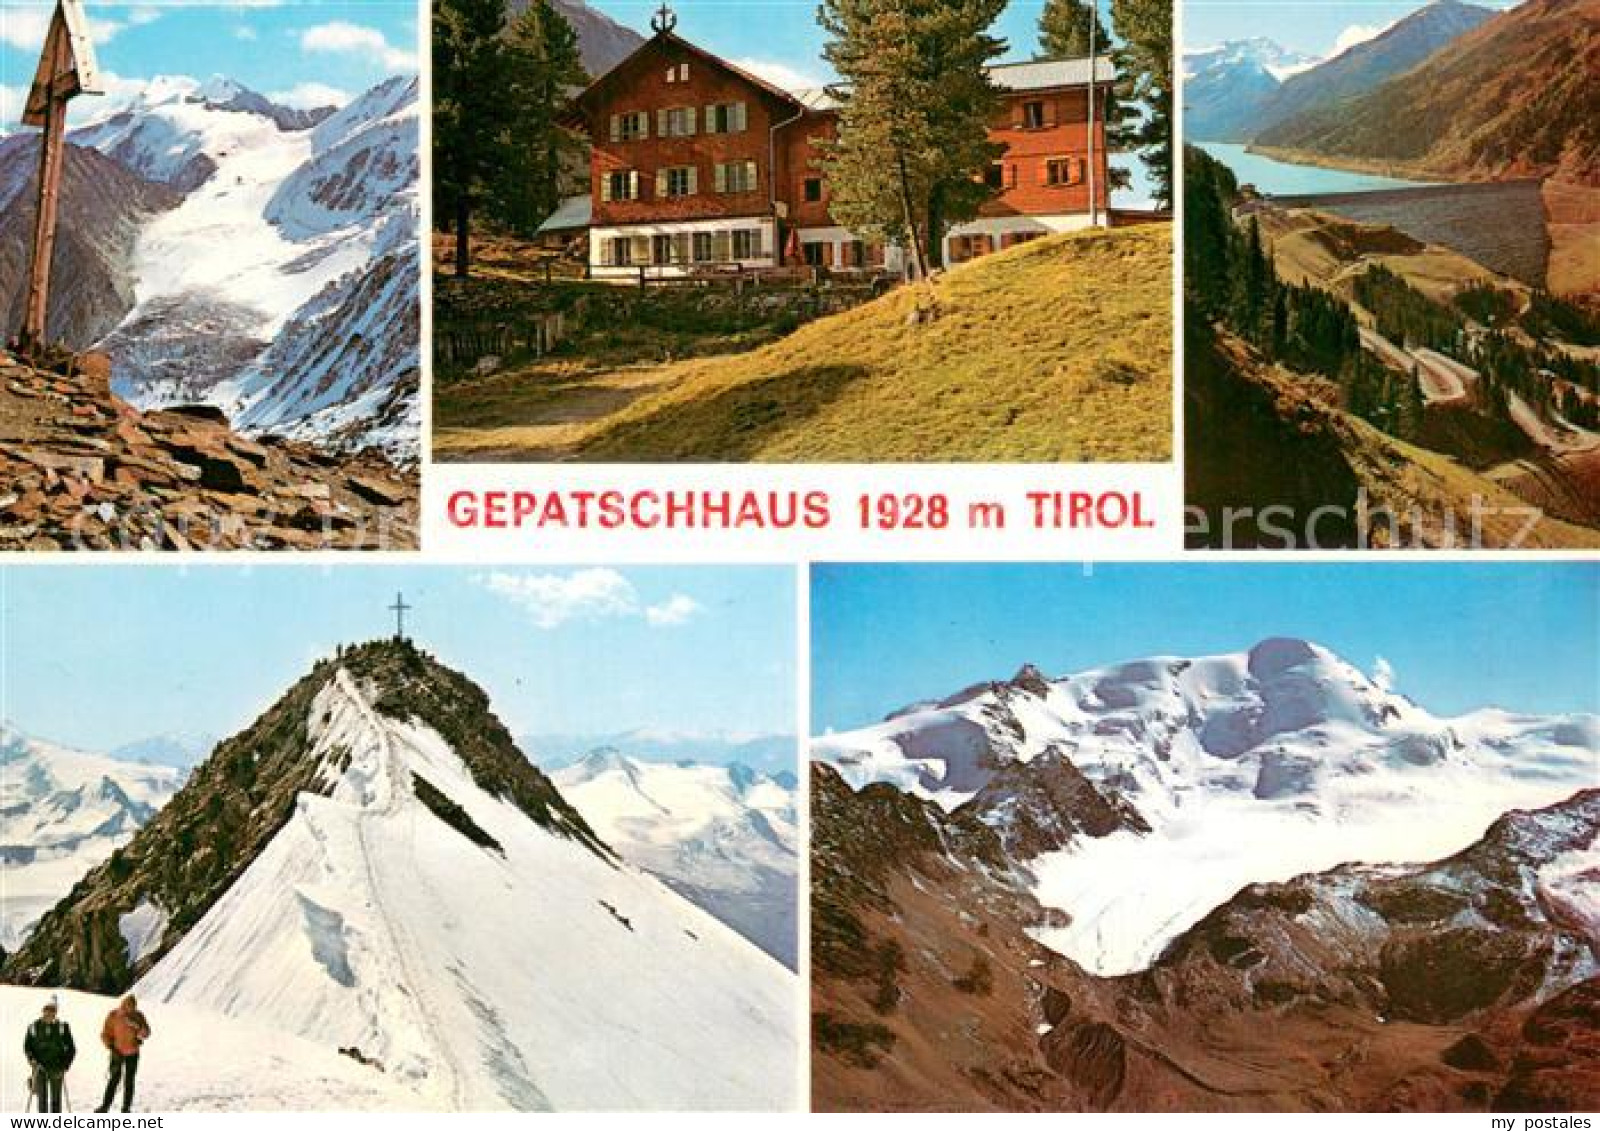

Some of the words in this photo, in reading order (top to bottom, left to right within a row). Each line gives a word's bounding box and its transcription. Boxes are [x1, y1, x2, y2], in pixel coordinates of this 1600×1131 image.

[447, 490, 831, 529] GEPATSCHHAUS
[857, 492, 949, 529] 1928
[968, 499, 1005, 529] m
[1026, 490, 1155, 529] TIROL
